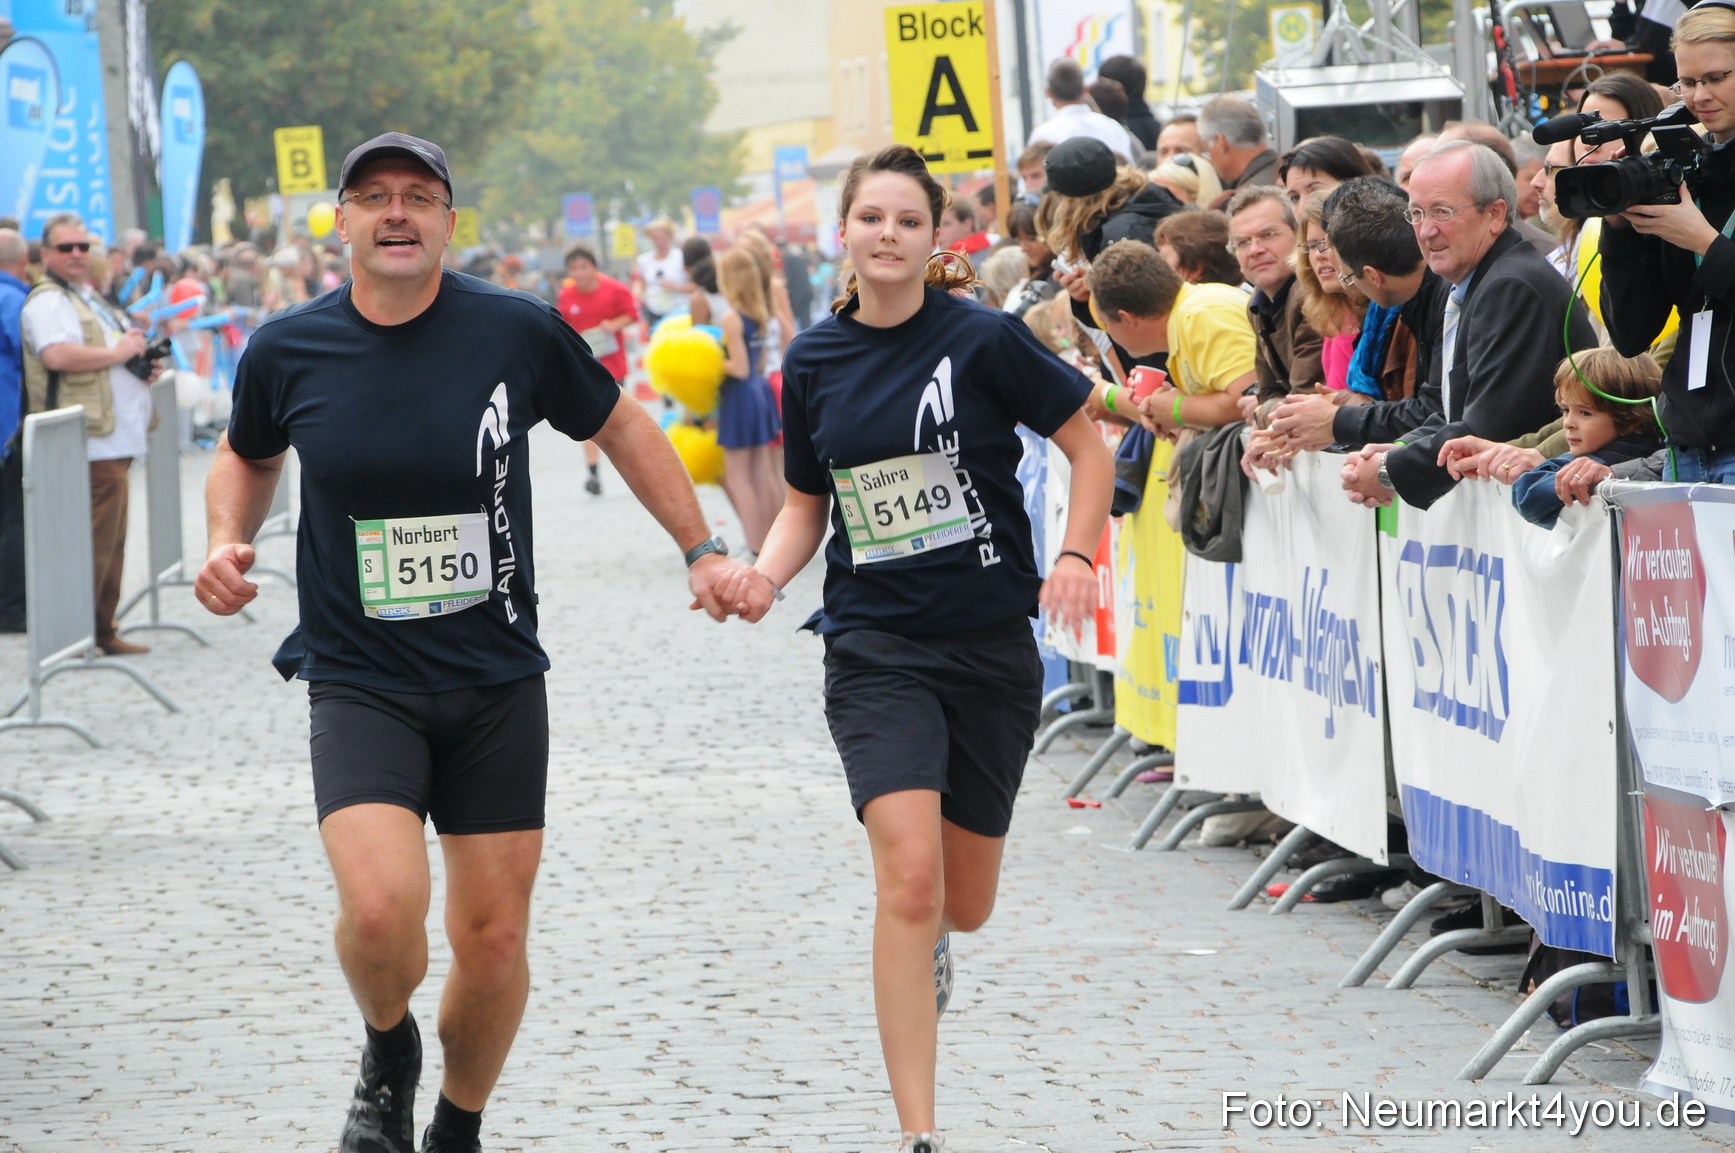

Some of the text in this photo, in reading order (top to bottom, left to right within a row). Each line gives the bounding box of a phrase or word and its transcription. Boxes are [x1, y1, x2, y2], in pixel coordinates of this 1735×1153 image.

[897, 8, 984, 41] Block
[917, 55, 979, 136] A
[289, 147, 311, 178] B
[860, 469, 909, 491] Sahra
[874, 485, 951, 526] 5149
[392, 525, 458, 545] Norbert
[1627, 527, 1693, 581] Wir verkaufen
[364, 552, 478, 585] S 5150
[1633, 602, 1649, 647] im
[1650, 596, 1692, 662] Auftrag!
[1655, 826, 1677, 874] Wir
[1654, 893, 1719, 967] im Auftrag!
